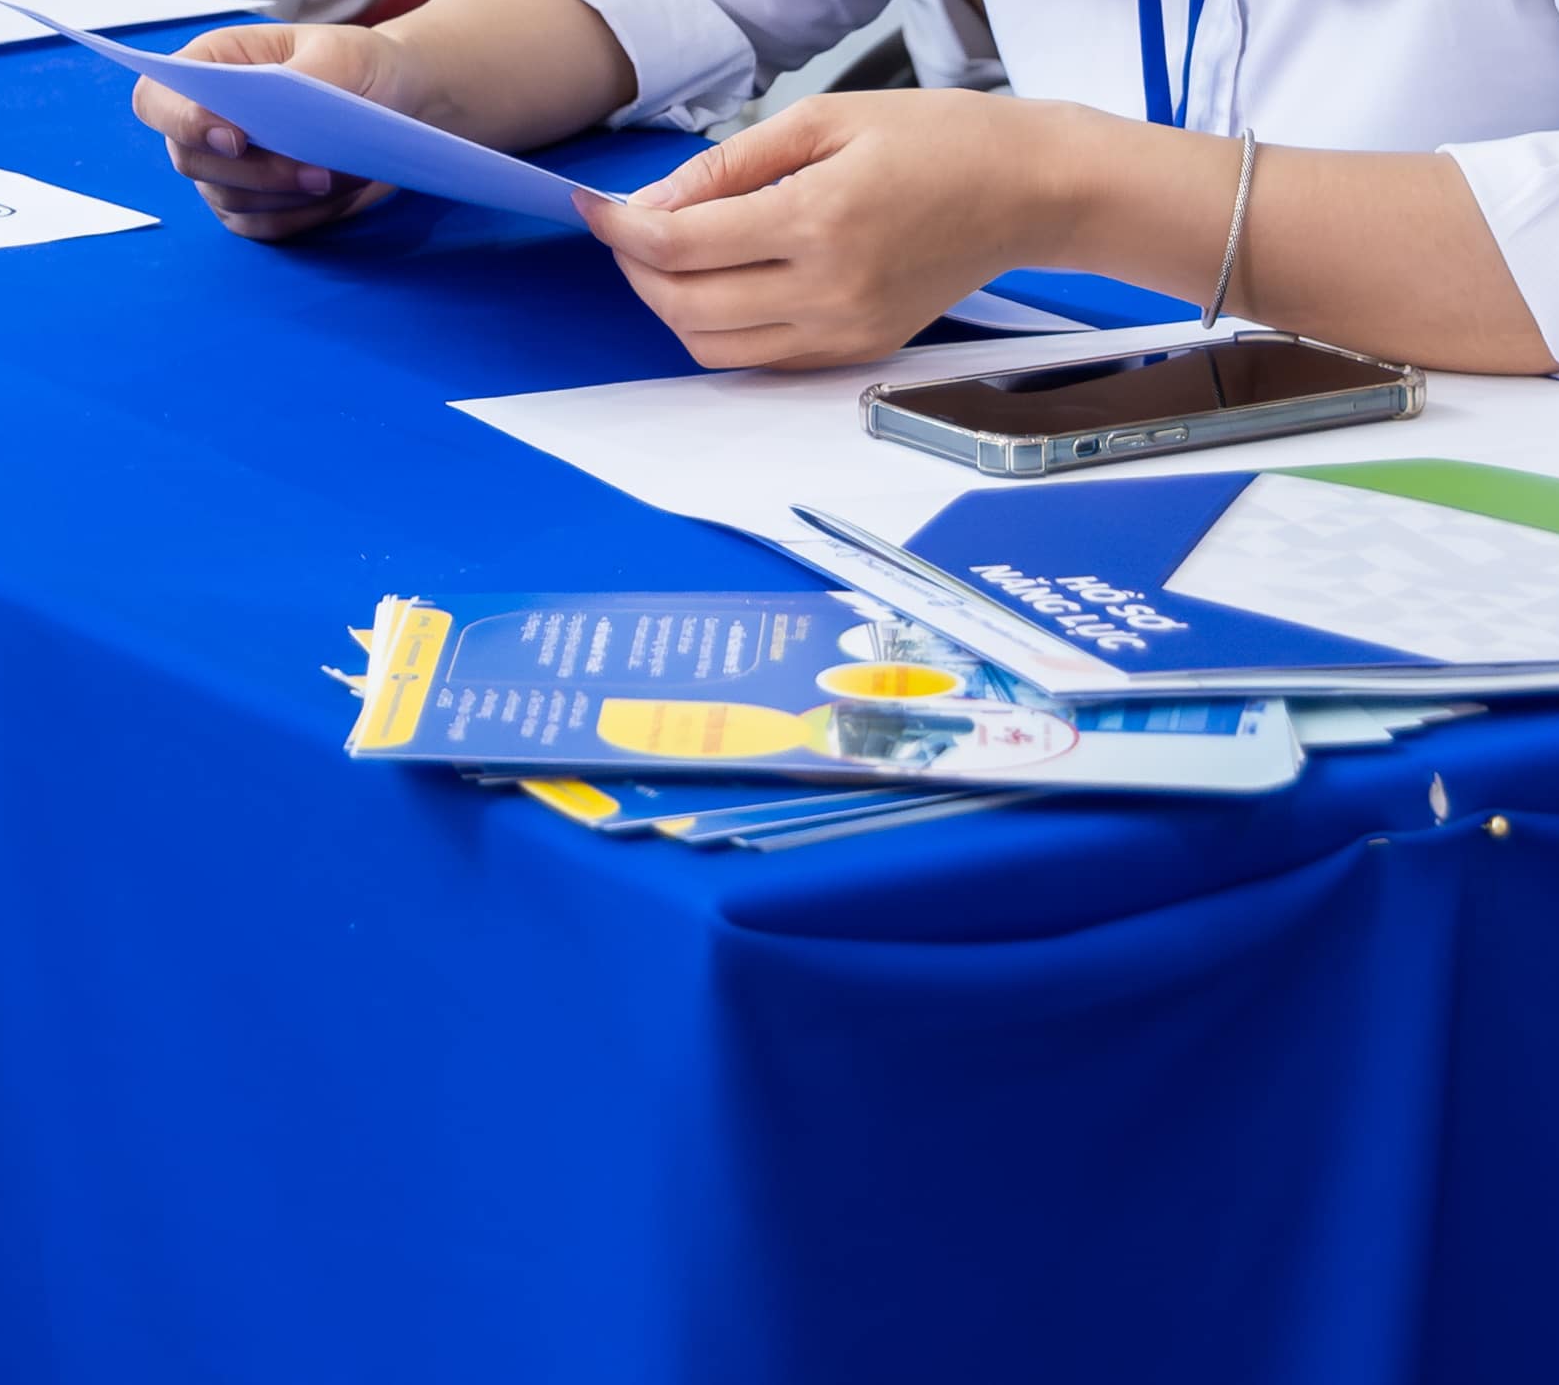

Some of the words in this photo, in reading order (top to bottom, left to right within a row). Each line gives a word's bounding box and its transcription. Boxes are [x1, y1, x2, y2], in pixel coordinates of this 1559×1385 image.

[968, 564, 1082, 615] NĂNG
[1055, 575, 1145, 604] HỒ
[1105, 603, 1188, 631] SƠ
